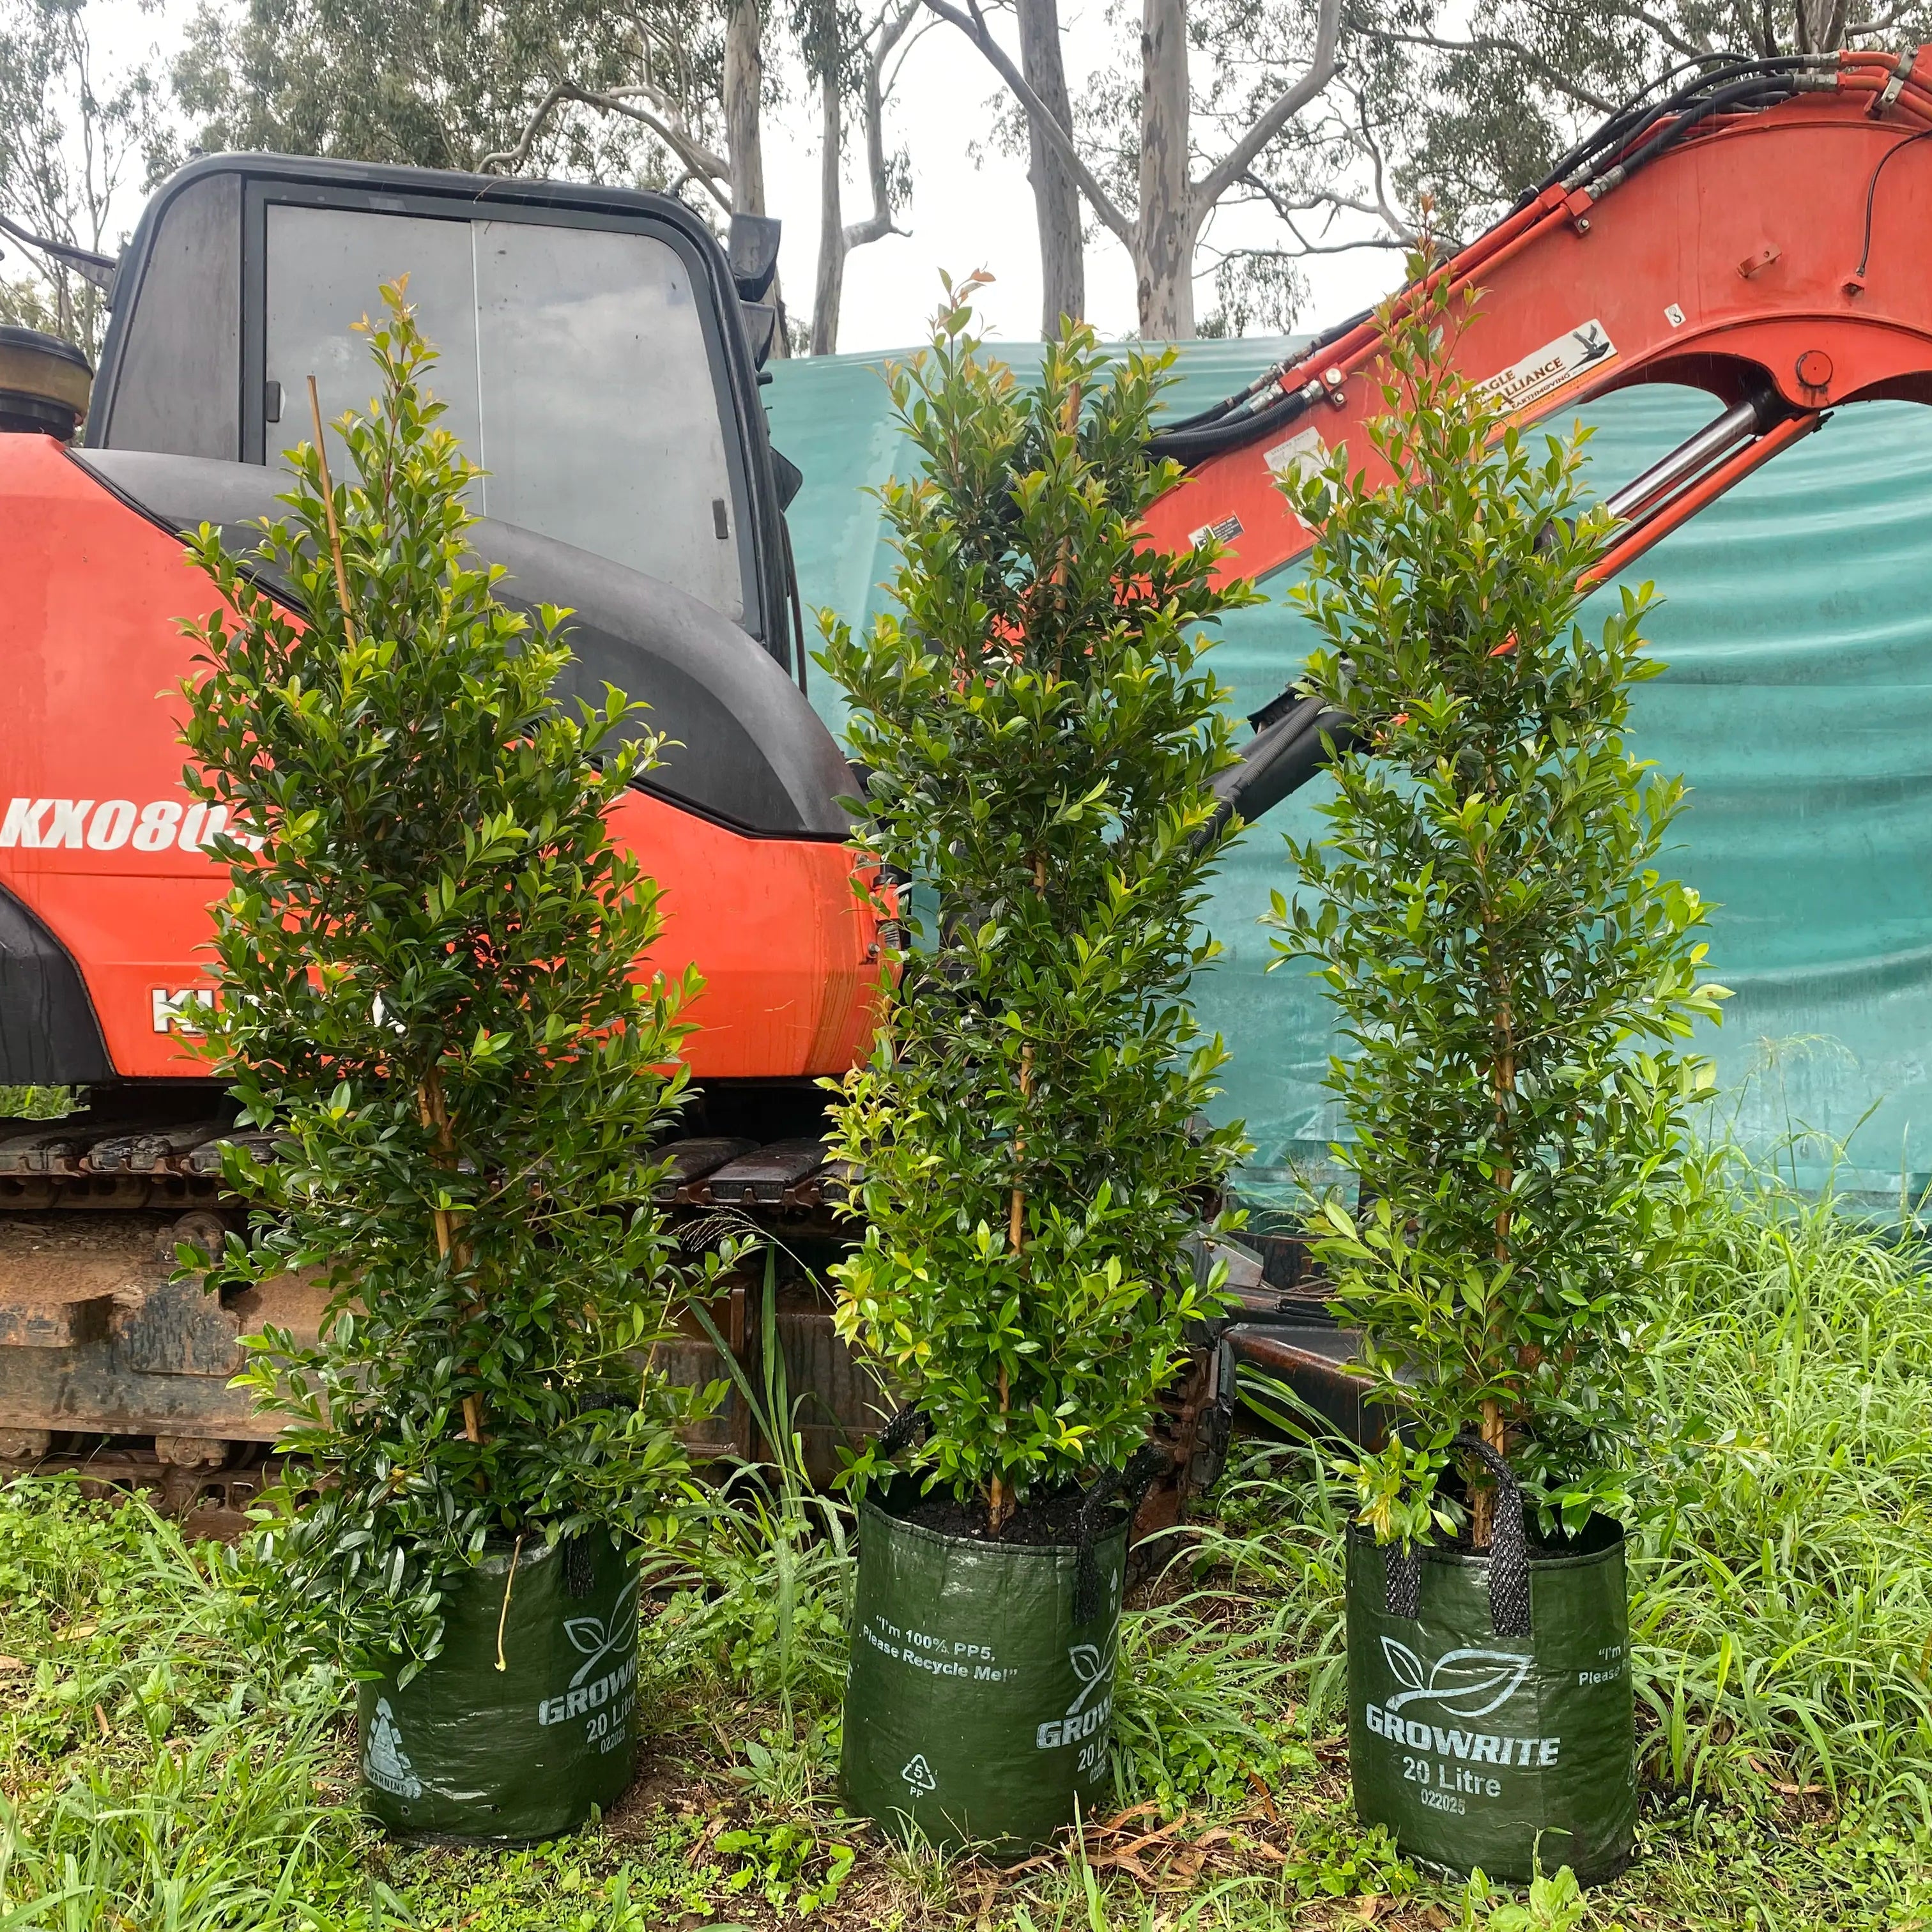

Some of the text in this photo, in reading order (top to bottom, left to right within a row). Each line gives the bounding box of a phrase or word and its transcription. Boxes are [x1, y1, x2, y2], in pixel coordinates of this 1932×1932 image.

[1472, 370, 1515, 400] AGLE
[1511, 372, 1571, 410] EARTHMOVING
[862, 1624, 900, 1659] Please
[903, 1648, 976, 1678] Recycle
[905, 1630, 950, 1655] 100%
[1579, 1666, 1621, 1686] Please
[586, 1689, 636, 1744] 20 Litre
[601, 1724, 625, 1755] 022025
[1366, 1703, 1561, 1766] GROWRITE
[914, 1764, 924, 1779] 5
[1077, 1744, 1094, 1773] 20
[910, 1786, 924, 1798] PP
[1403, 1756, 1501, 1798] 20 Litre
[1420, 1788, 1466, 1815] 022025
